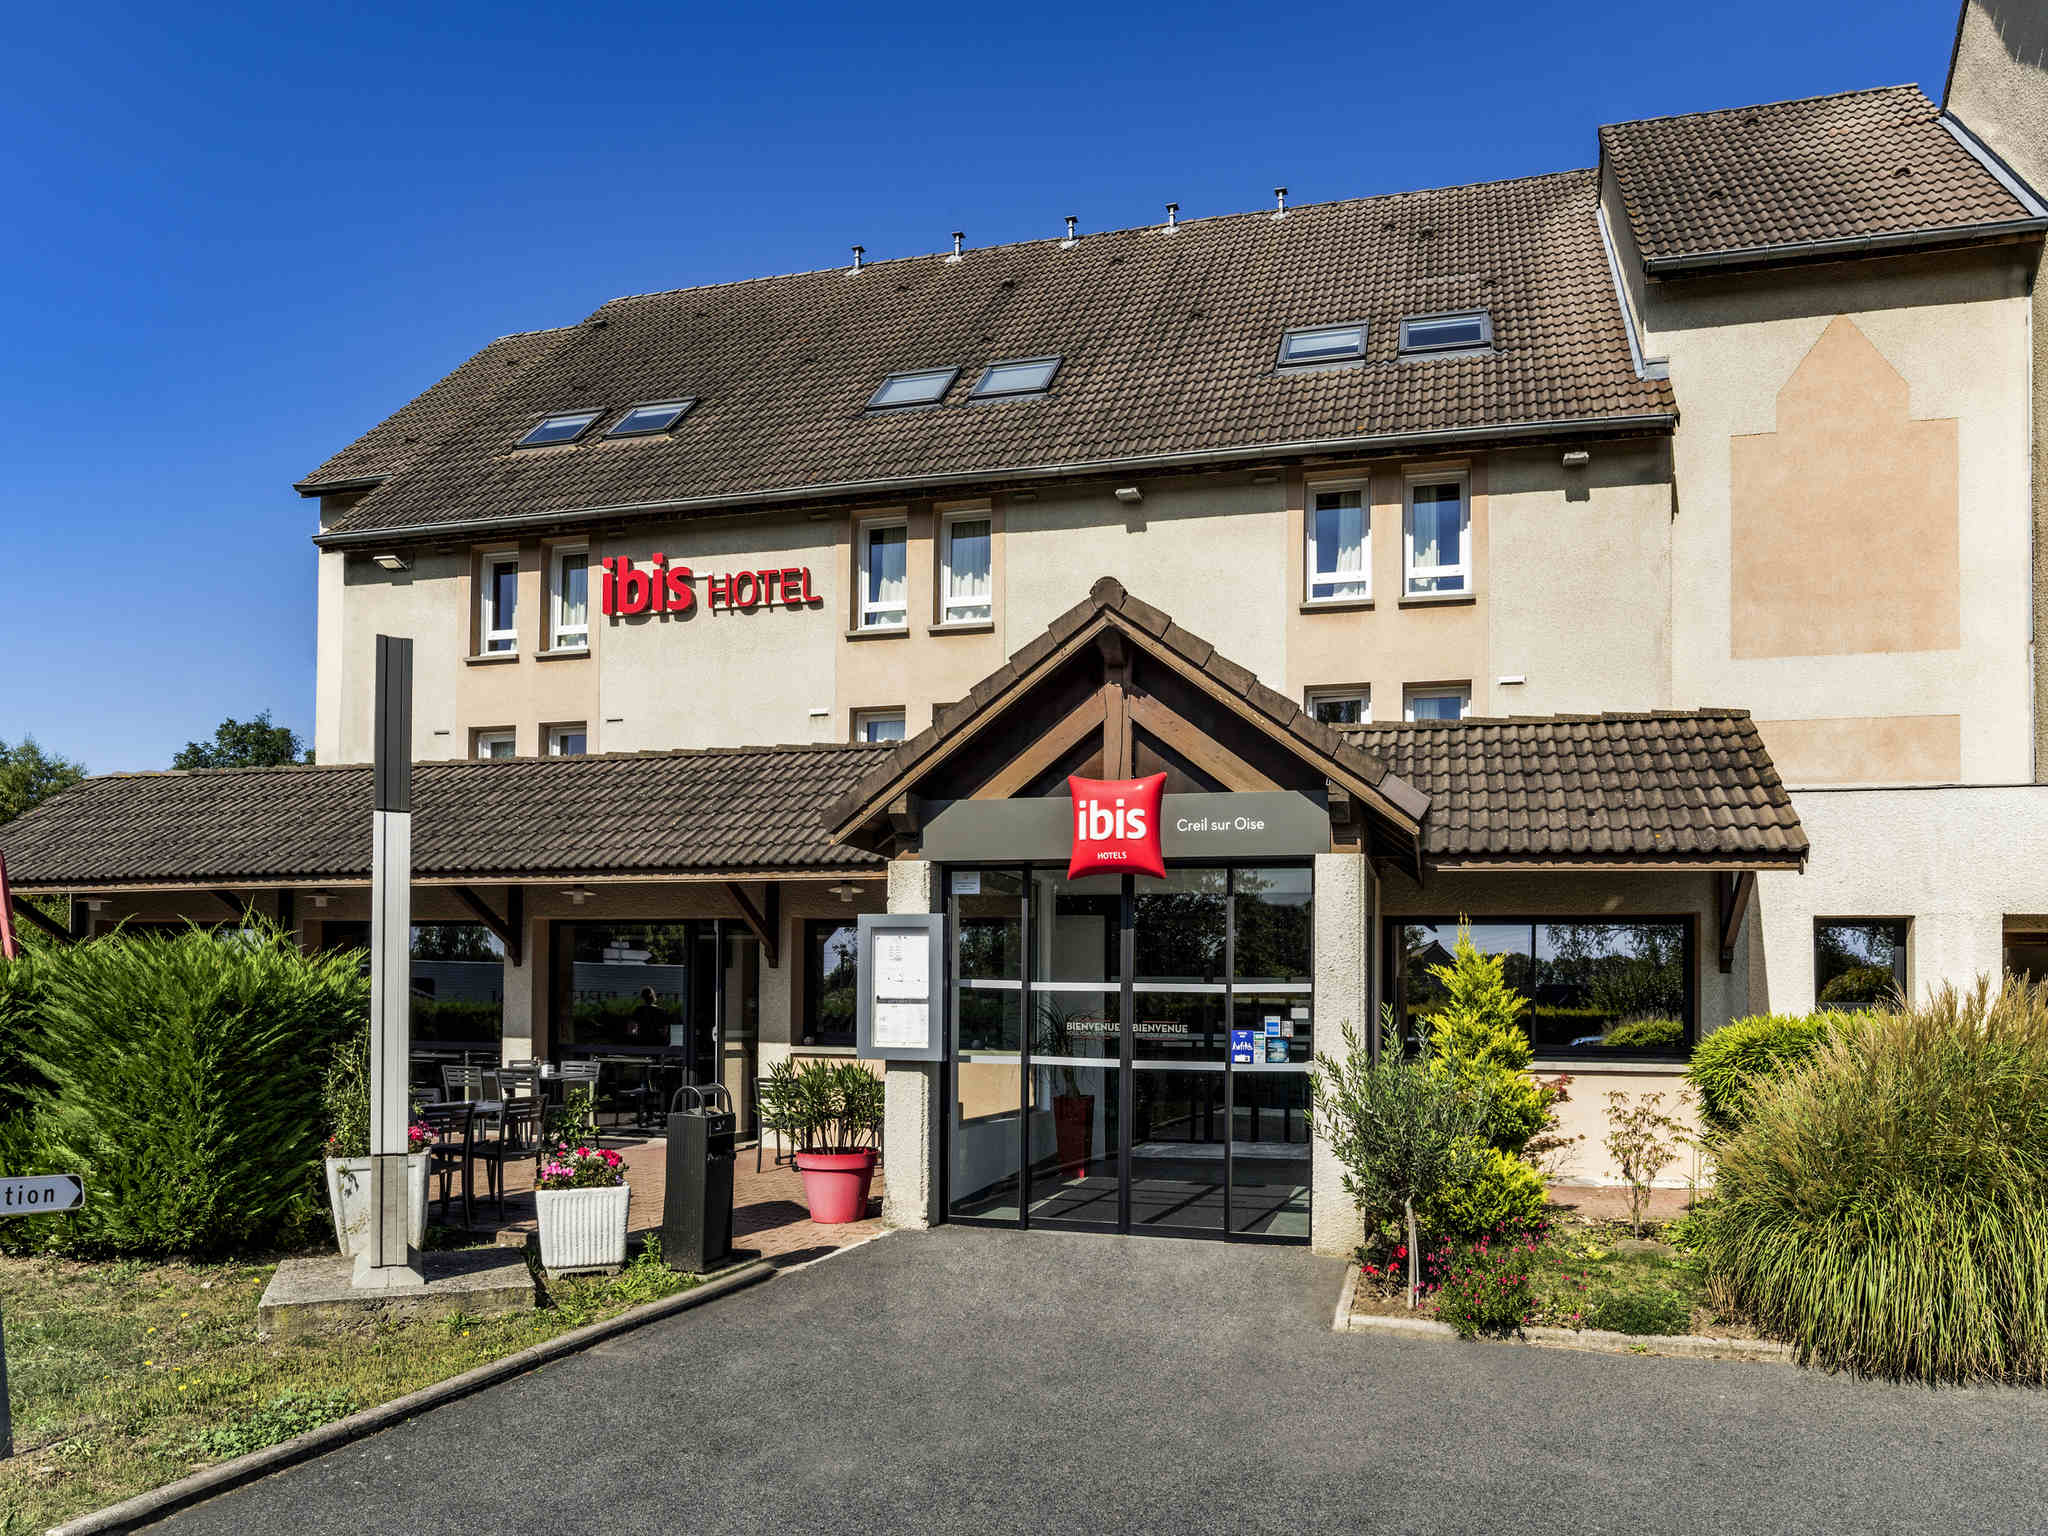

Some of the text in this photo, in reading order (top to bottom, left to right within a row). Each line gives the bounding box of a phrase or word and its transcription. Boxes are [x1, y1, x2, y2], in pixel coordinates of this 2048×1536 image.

[602, 552, 823, 615] ibis HOTEL
[1078, 799, 1147, 840] ibis
[1177, 817, 1264, 832] Creil sur Oise
[1097, 851, 1127, 860] HOTELS
[1066, 1022, 1121, 1032] BIENVENUE
[1132, 1023, 1188, 1033] BIENVENUE
[5, 1185, 55, 1206] tion
